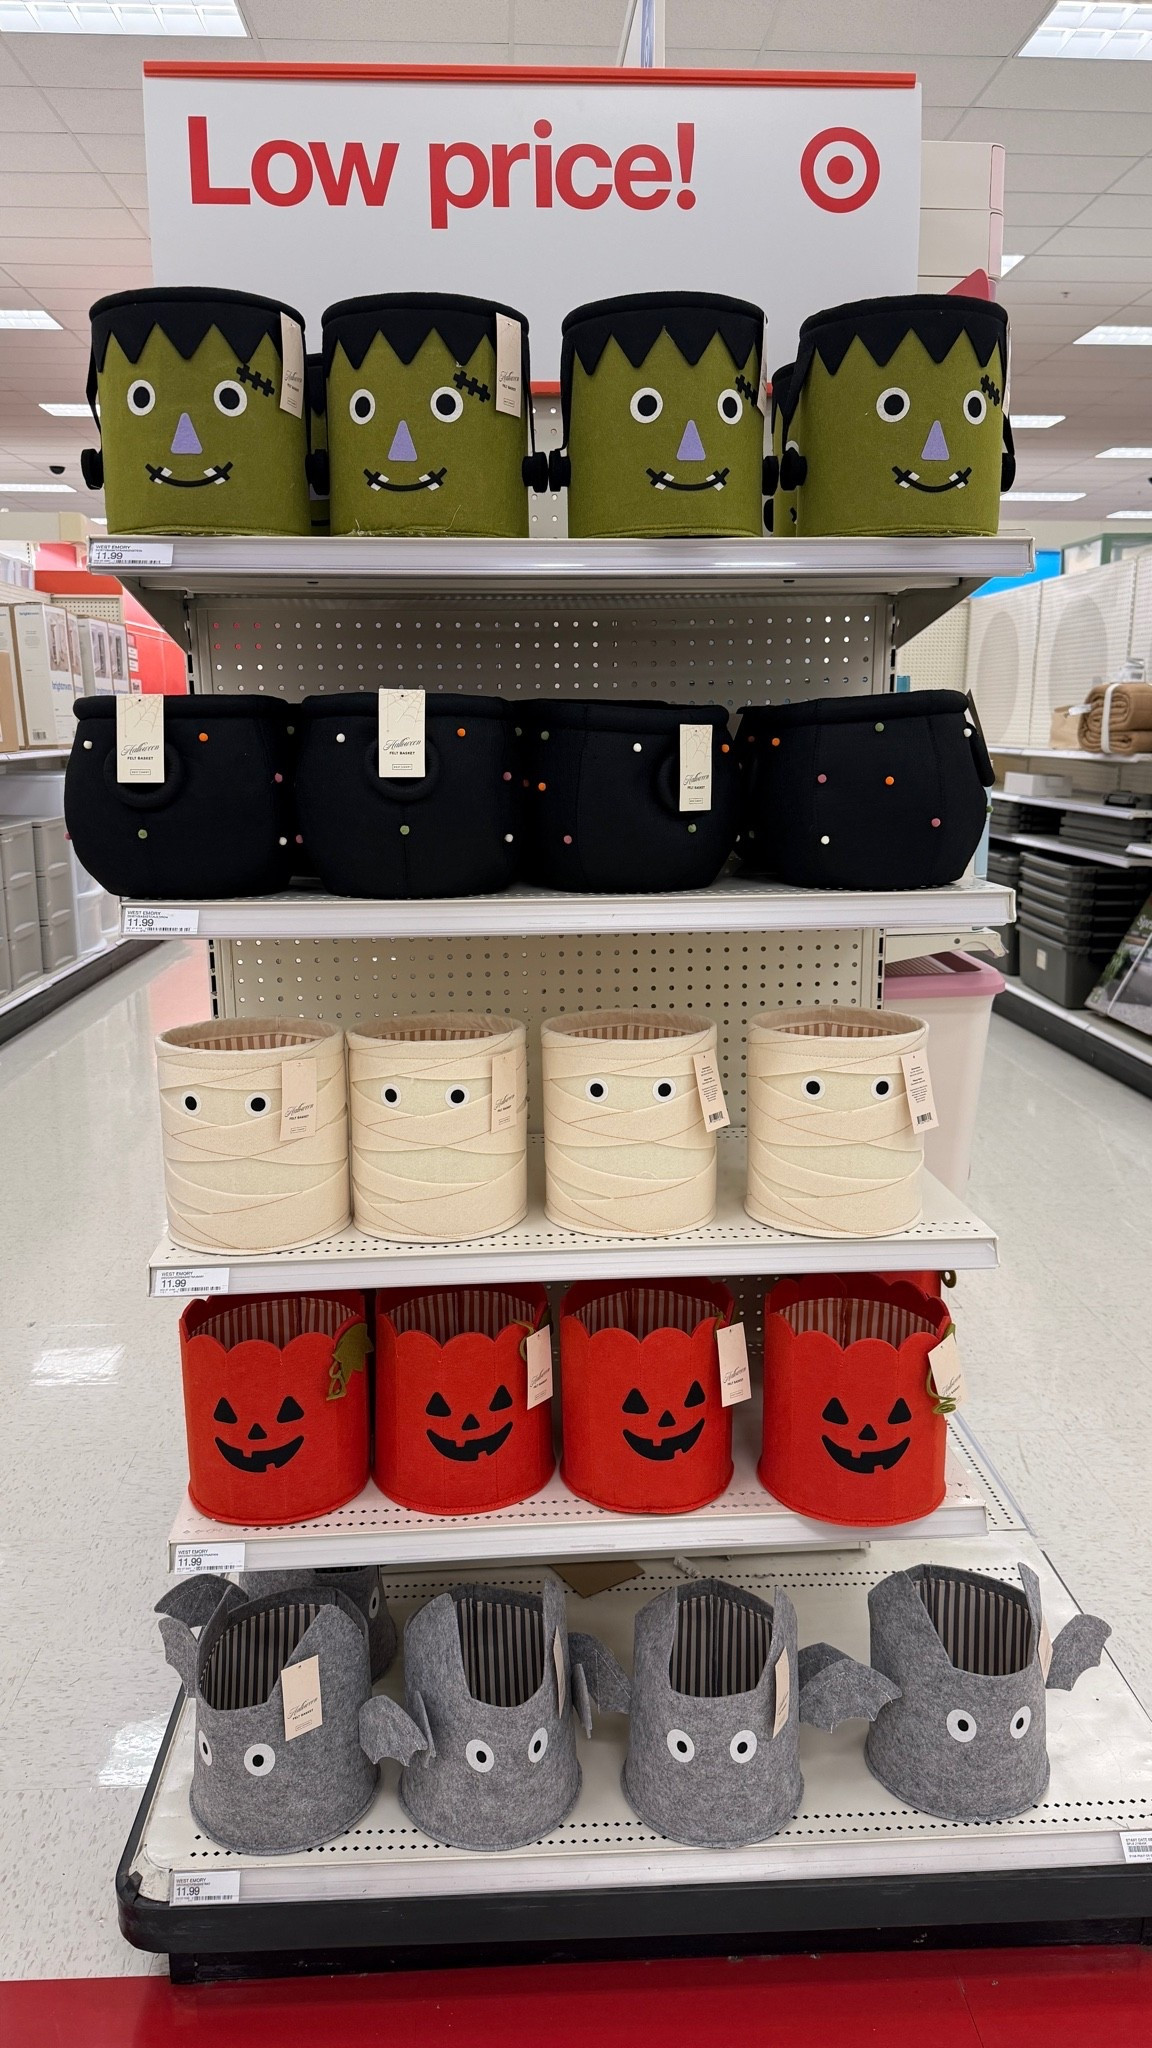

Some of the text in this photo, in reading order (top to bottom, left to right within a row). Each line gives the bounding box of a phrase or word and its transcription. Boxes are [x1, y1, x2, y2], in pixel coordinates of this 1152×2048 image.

[188, 115, 696, 229] Low price!
[95, 551, 124, 560] 11.99
[383, 736, 422, 751] Halloween
[120, 741, 160, 757] Halloween
[127, 918, 155, 927] 11.99
[162, 1279, 188, 1288] 11.99
[178, 1557, 203, 1567] 11.99
[176, 1886, 201, 1896] 11.99
